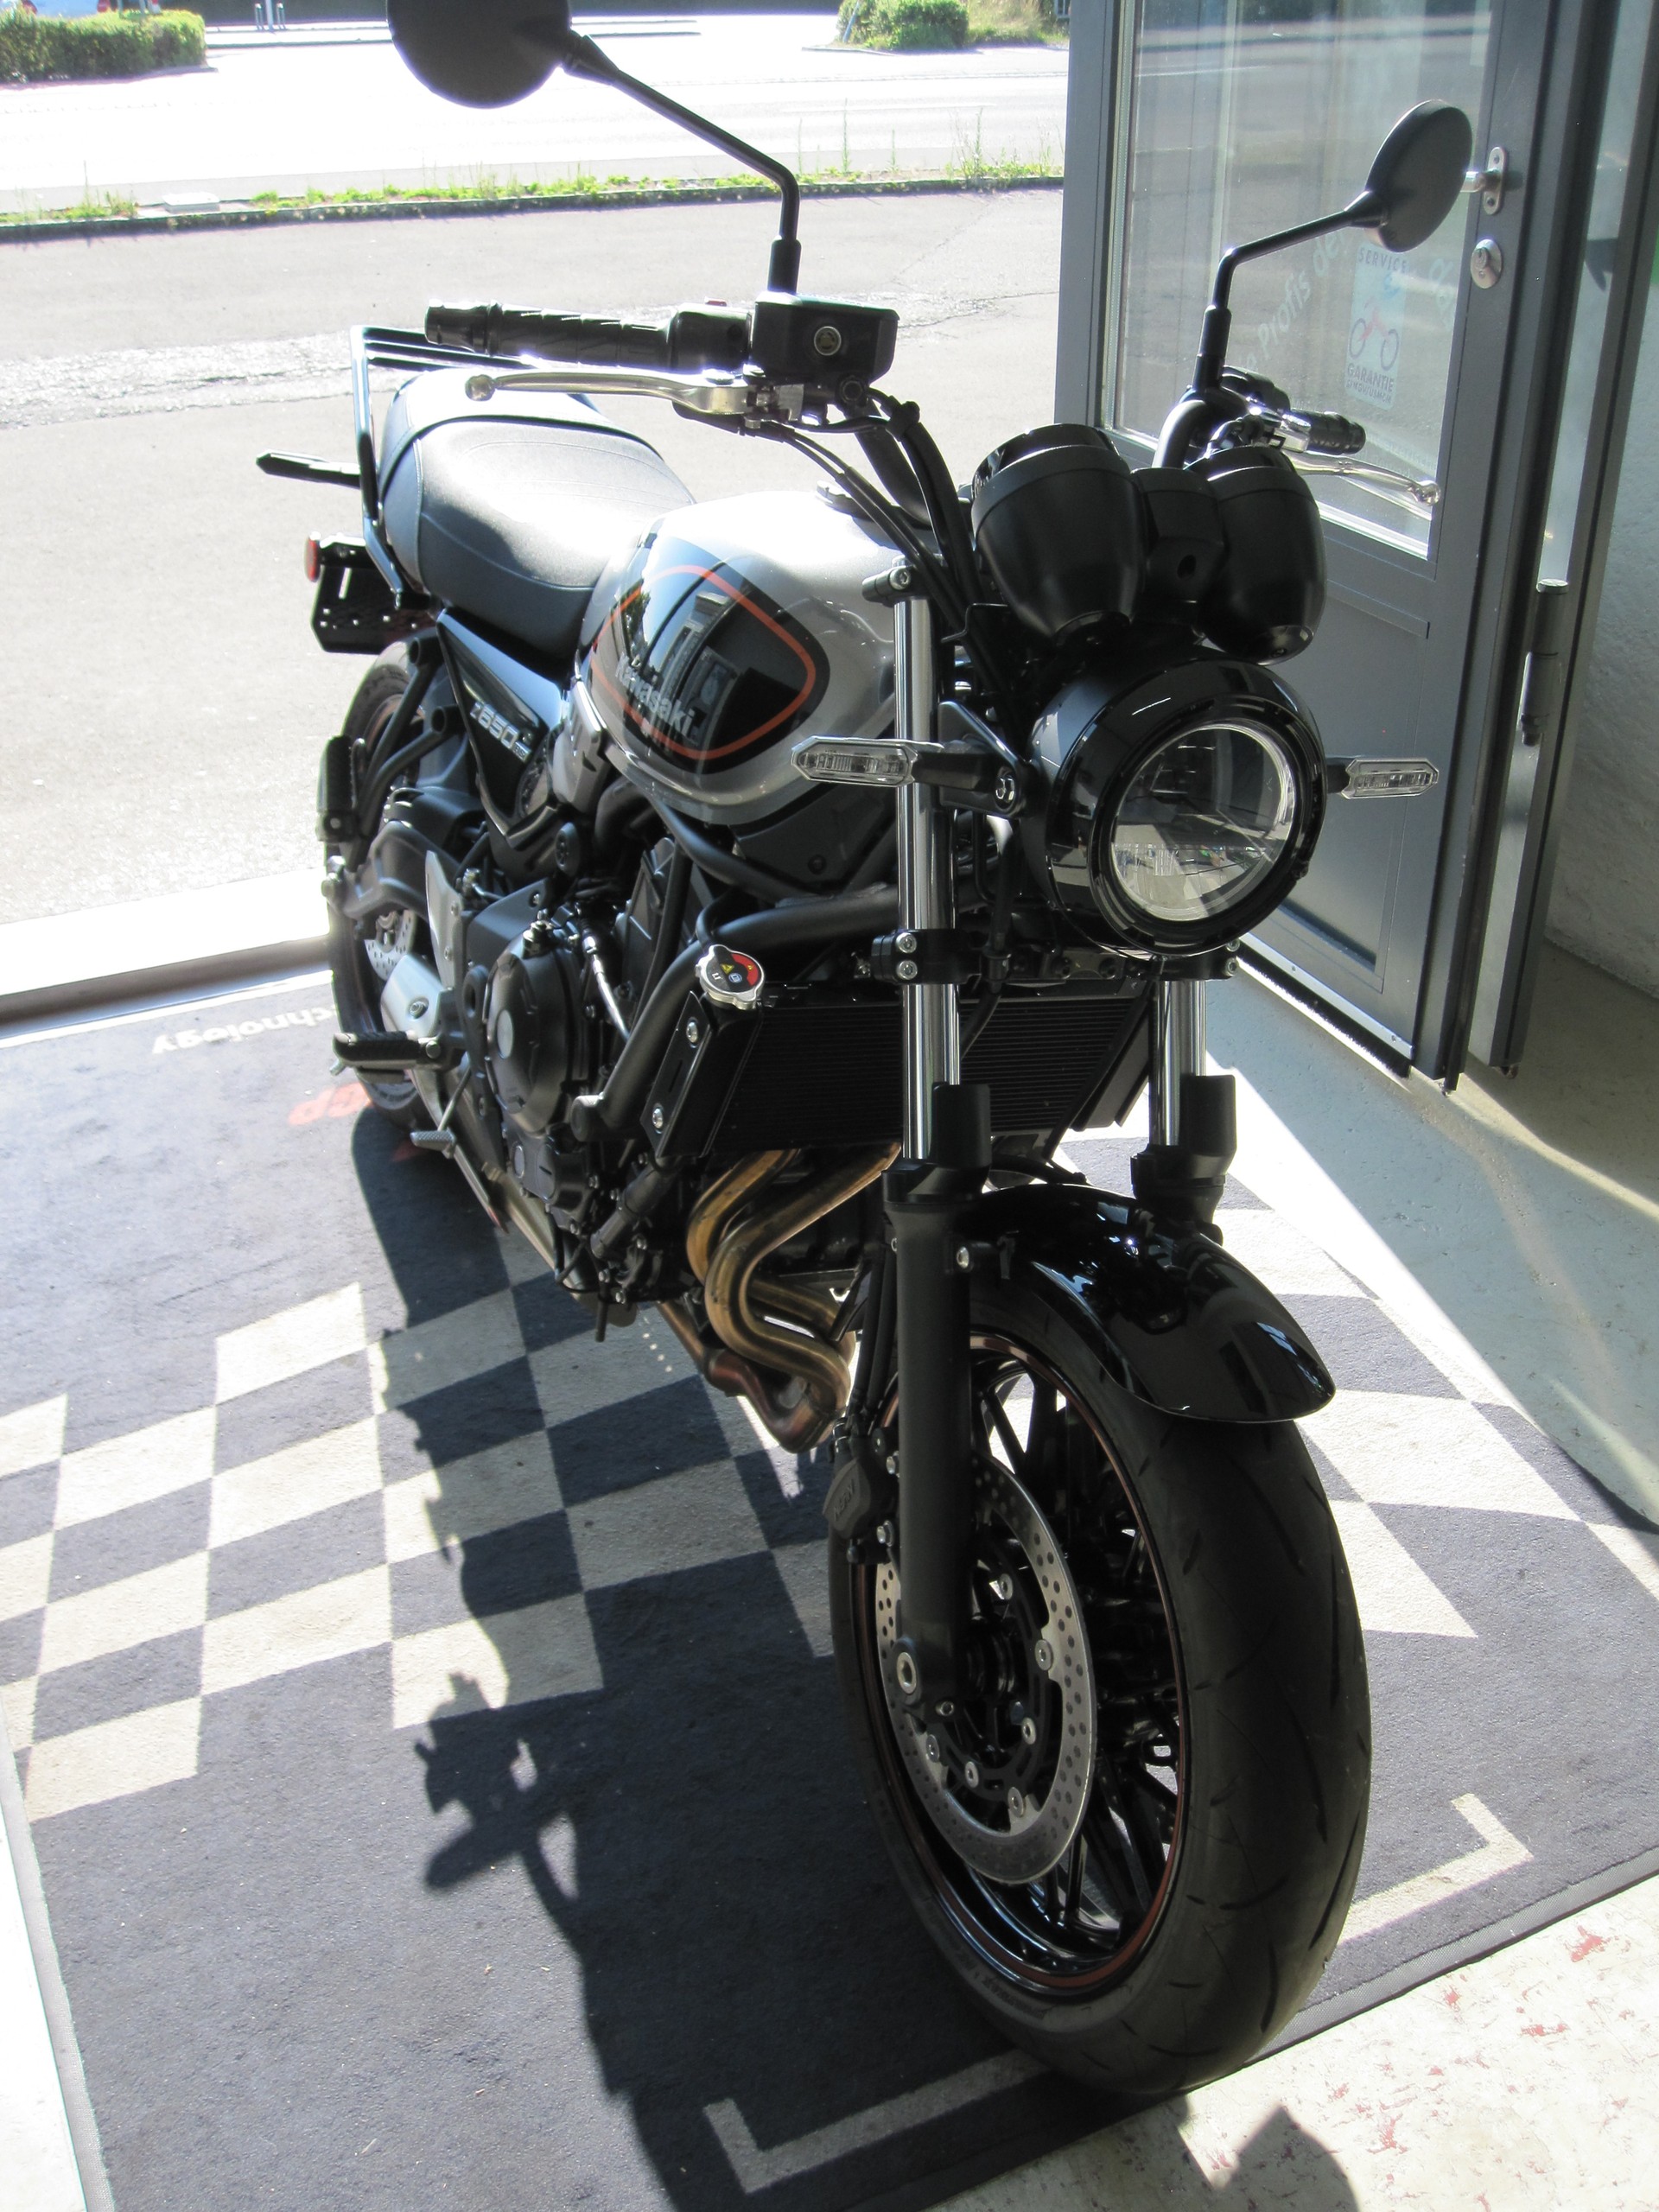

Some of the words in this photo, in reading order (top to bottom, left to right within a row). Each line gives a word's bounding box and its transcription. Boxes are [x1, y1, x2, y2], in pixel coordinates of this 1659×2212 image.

[1357, 246, 1409, 275] SERVICE
[1347, 362, 1395, 393] GARANTIE
[614, 651, 696, 737] Kawasaki
[151, 1004, 337, 1055] chnology
